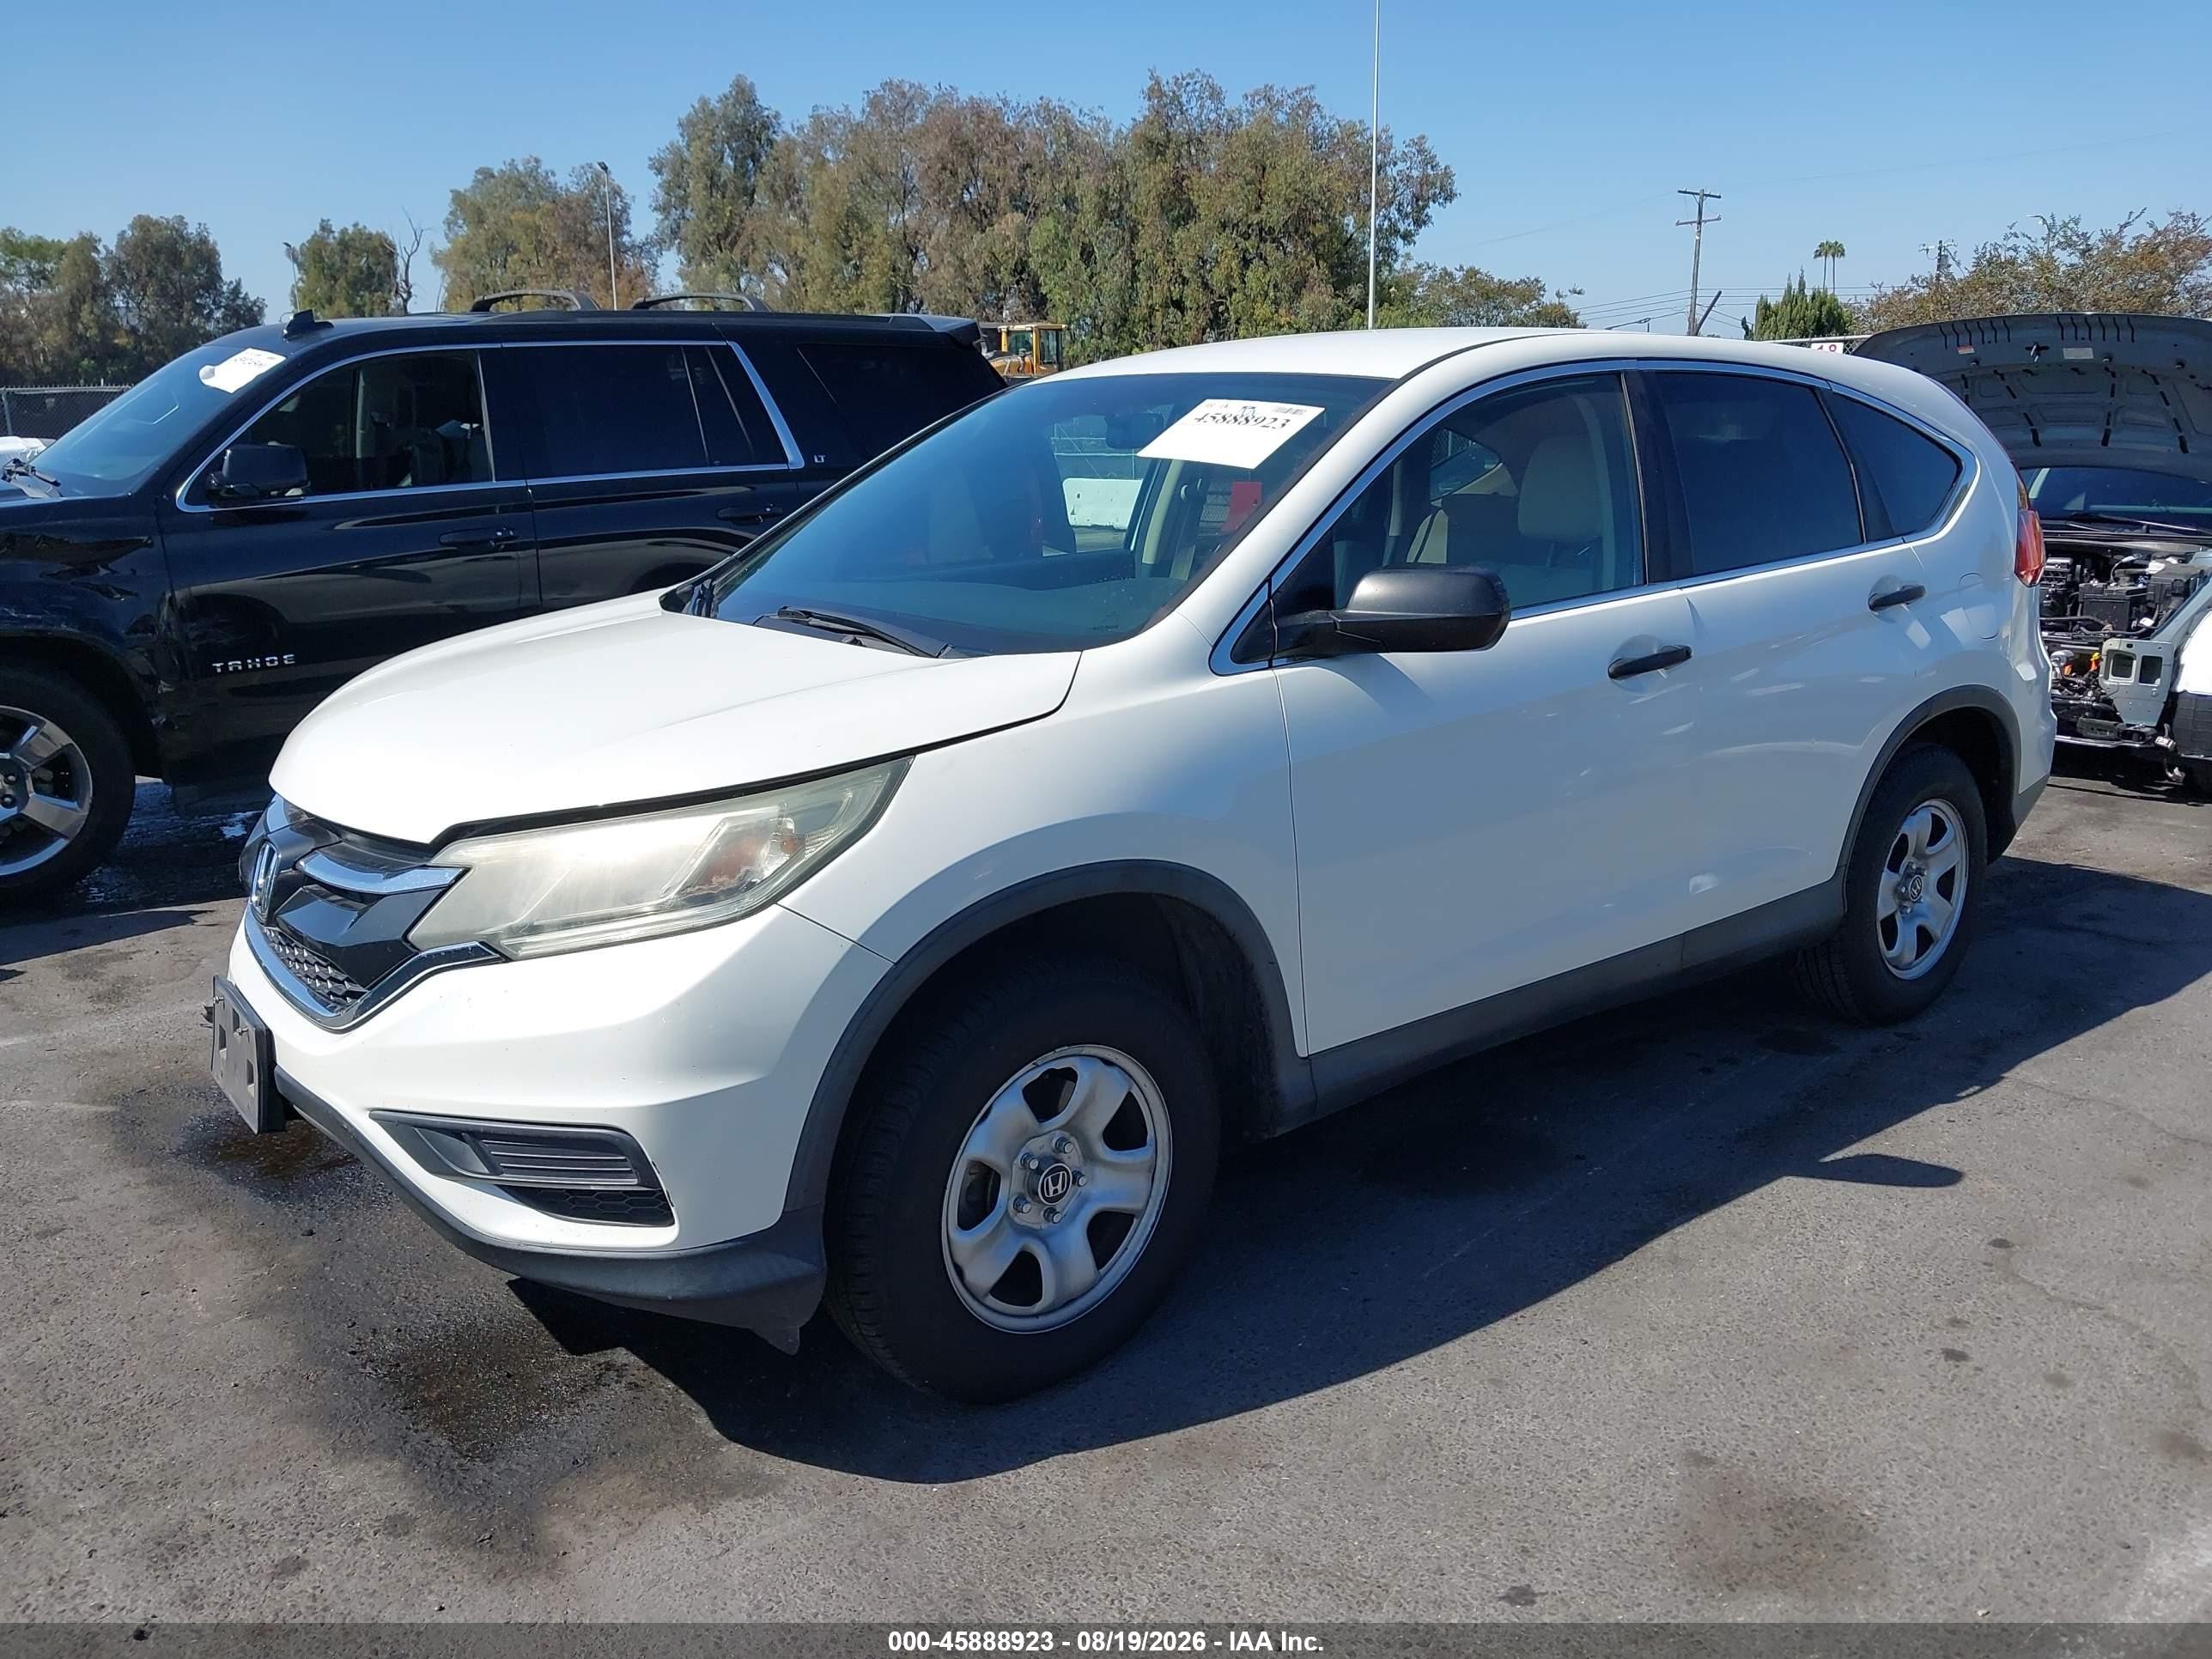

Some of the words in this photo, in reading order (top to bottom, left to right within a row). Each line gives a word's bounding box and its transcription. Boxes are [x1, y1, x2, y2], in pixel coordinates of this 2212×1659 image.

[1194, 412, 1291, 429] 45888923
[813, 454, 826, 464] LT
[211, 653, 296, 673] TAHOE
